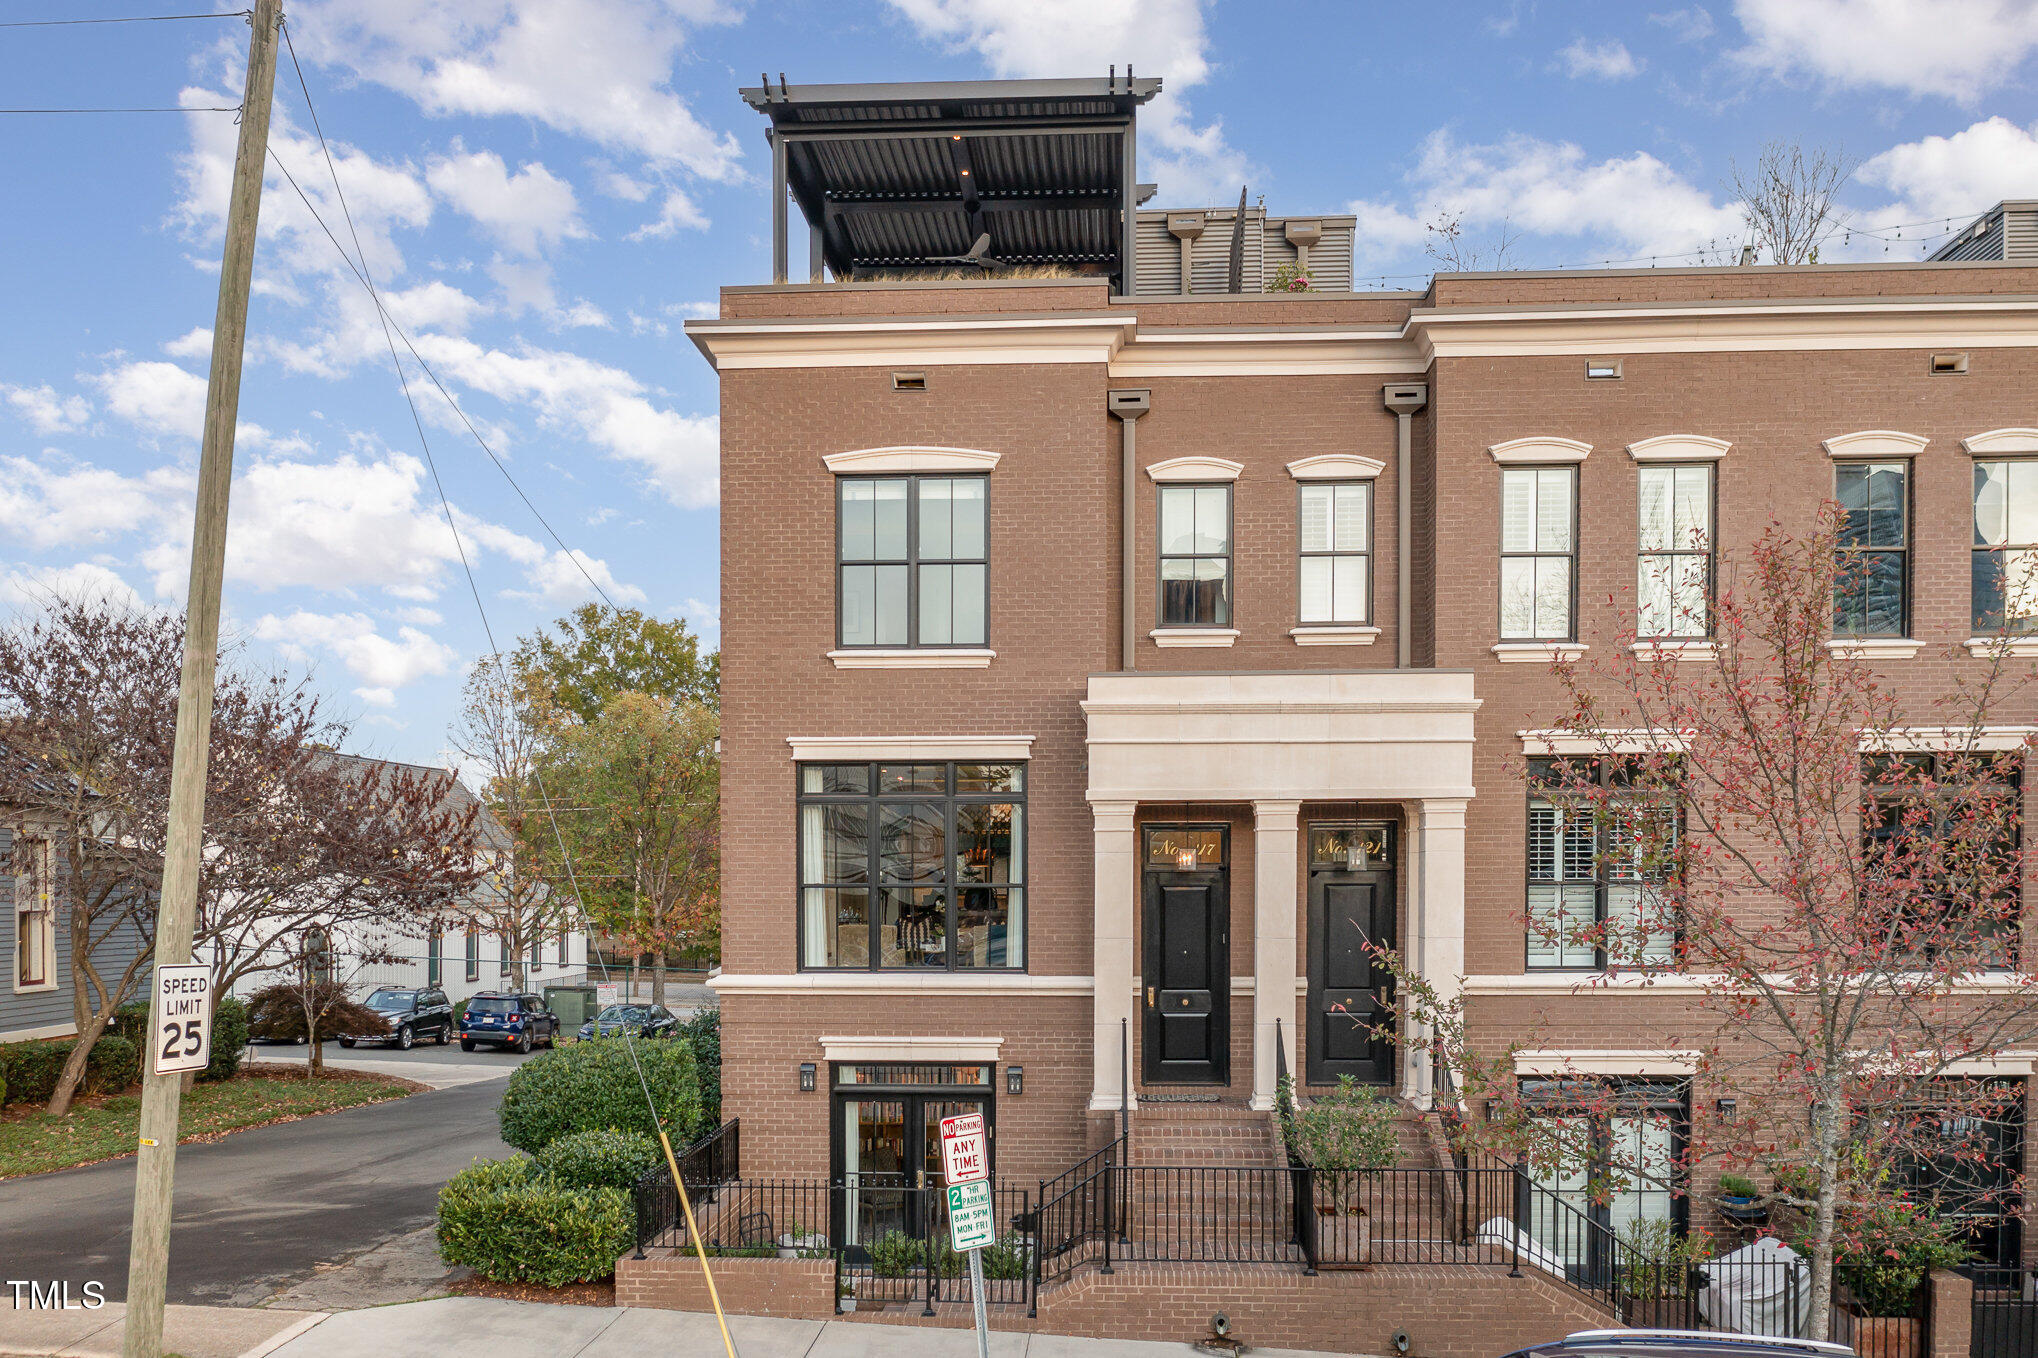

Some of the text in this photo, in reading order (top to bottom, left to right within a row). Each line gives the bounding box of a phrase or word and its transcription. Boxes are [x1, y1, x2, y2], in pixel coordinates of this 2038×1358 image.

[163, 978, 207, 994] SPEED
[167, 999, 202, 1016] LIMIT
[161, 1020, 202, 1060] 25
[943, 1120, 981, 1136] NO PARKING
[953, 1139, 975, 1154] ANY
[952, 1154, 979, 1170] TIME
[951, 1185, 979, 1206] 2 HR
[962, 1193, 988, 1205] PARKING
